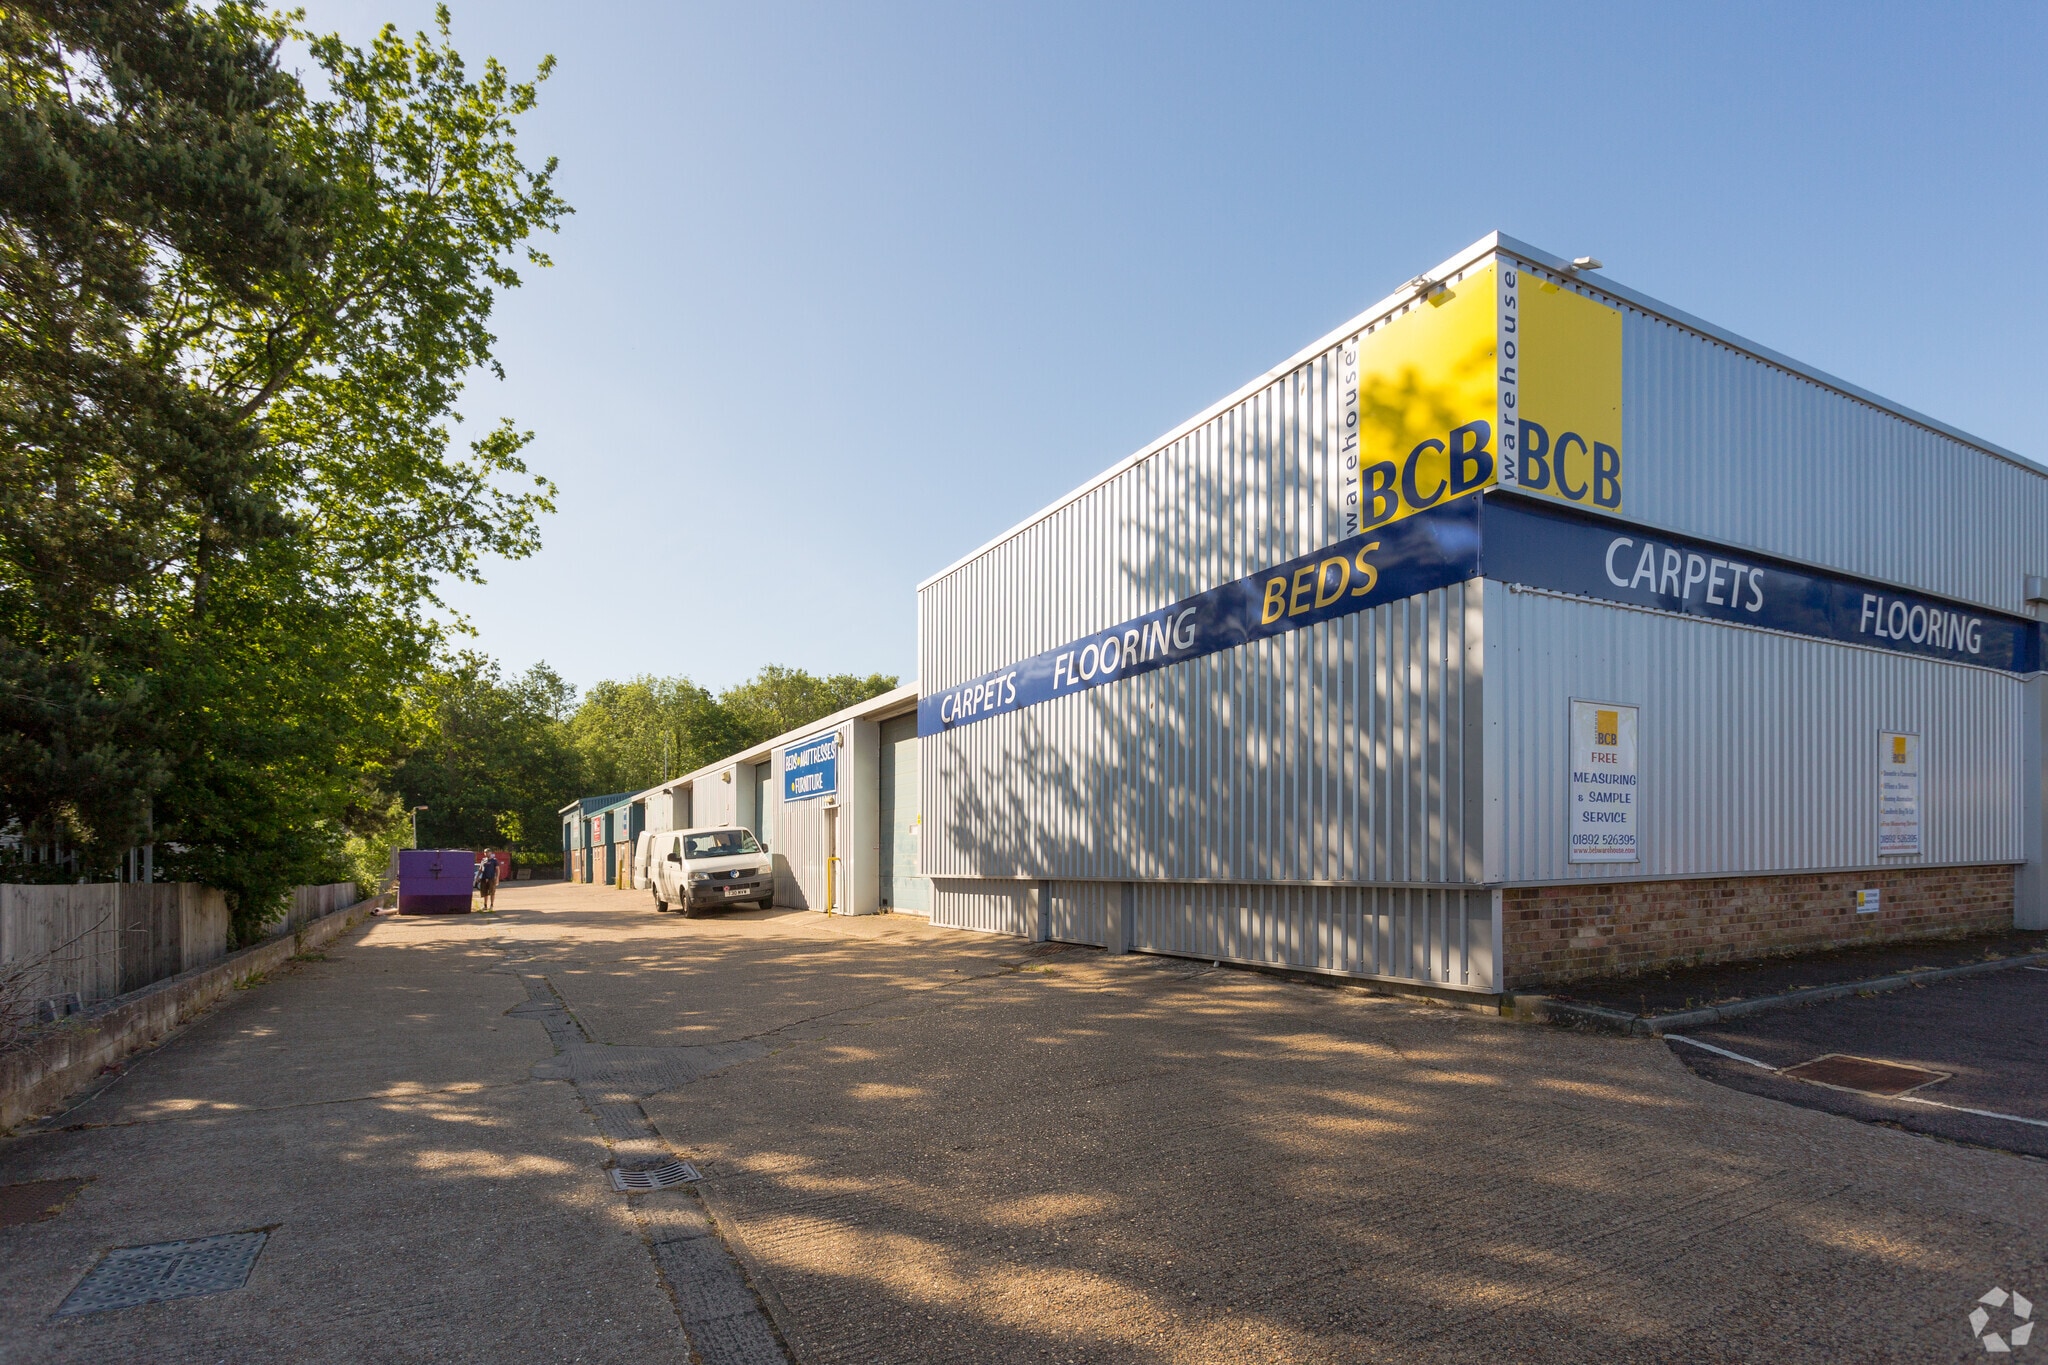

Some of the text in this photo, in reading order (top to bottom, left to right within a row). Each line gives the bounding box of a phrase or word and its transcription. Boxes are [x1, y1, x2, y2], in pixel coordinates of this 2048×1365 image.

[1500, 270, 1517, 480] warehouse
[1341, 350, 1357, 535] warehouse
[1361, 419, 1494, 530] BCB
[1518, 417, 1622, 511] BCB
[1604, 536, 1982, 655] CARPETS FLOORING
[940, 540, 1381, 724] CARPETS FLOORING BEDS
[1598, 732, 1617, 745] BCB
[785, 740, 836, 772] BEDS MATTRESSES
[1591, 752, 1618, 764] FREE
[794, 772, 823, 794] FURNITURE
[1573, 772, 1636, 786] MEASURING
[1578, 791, 1632, 804] & SAMPLE
[1582, 811, 1627, 823] SERVICE
[1572, 834, 1636, 846] 01892 526395
